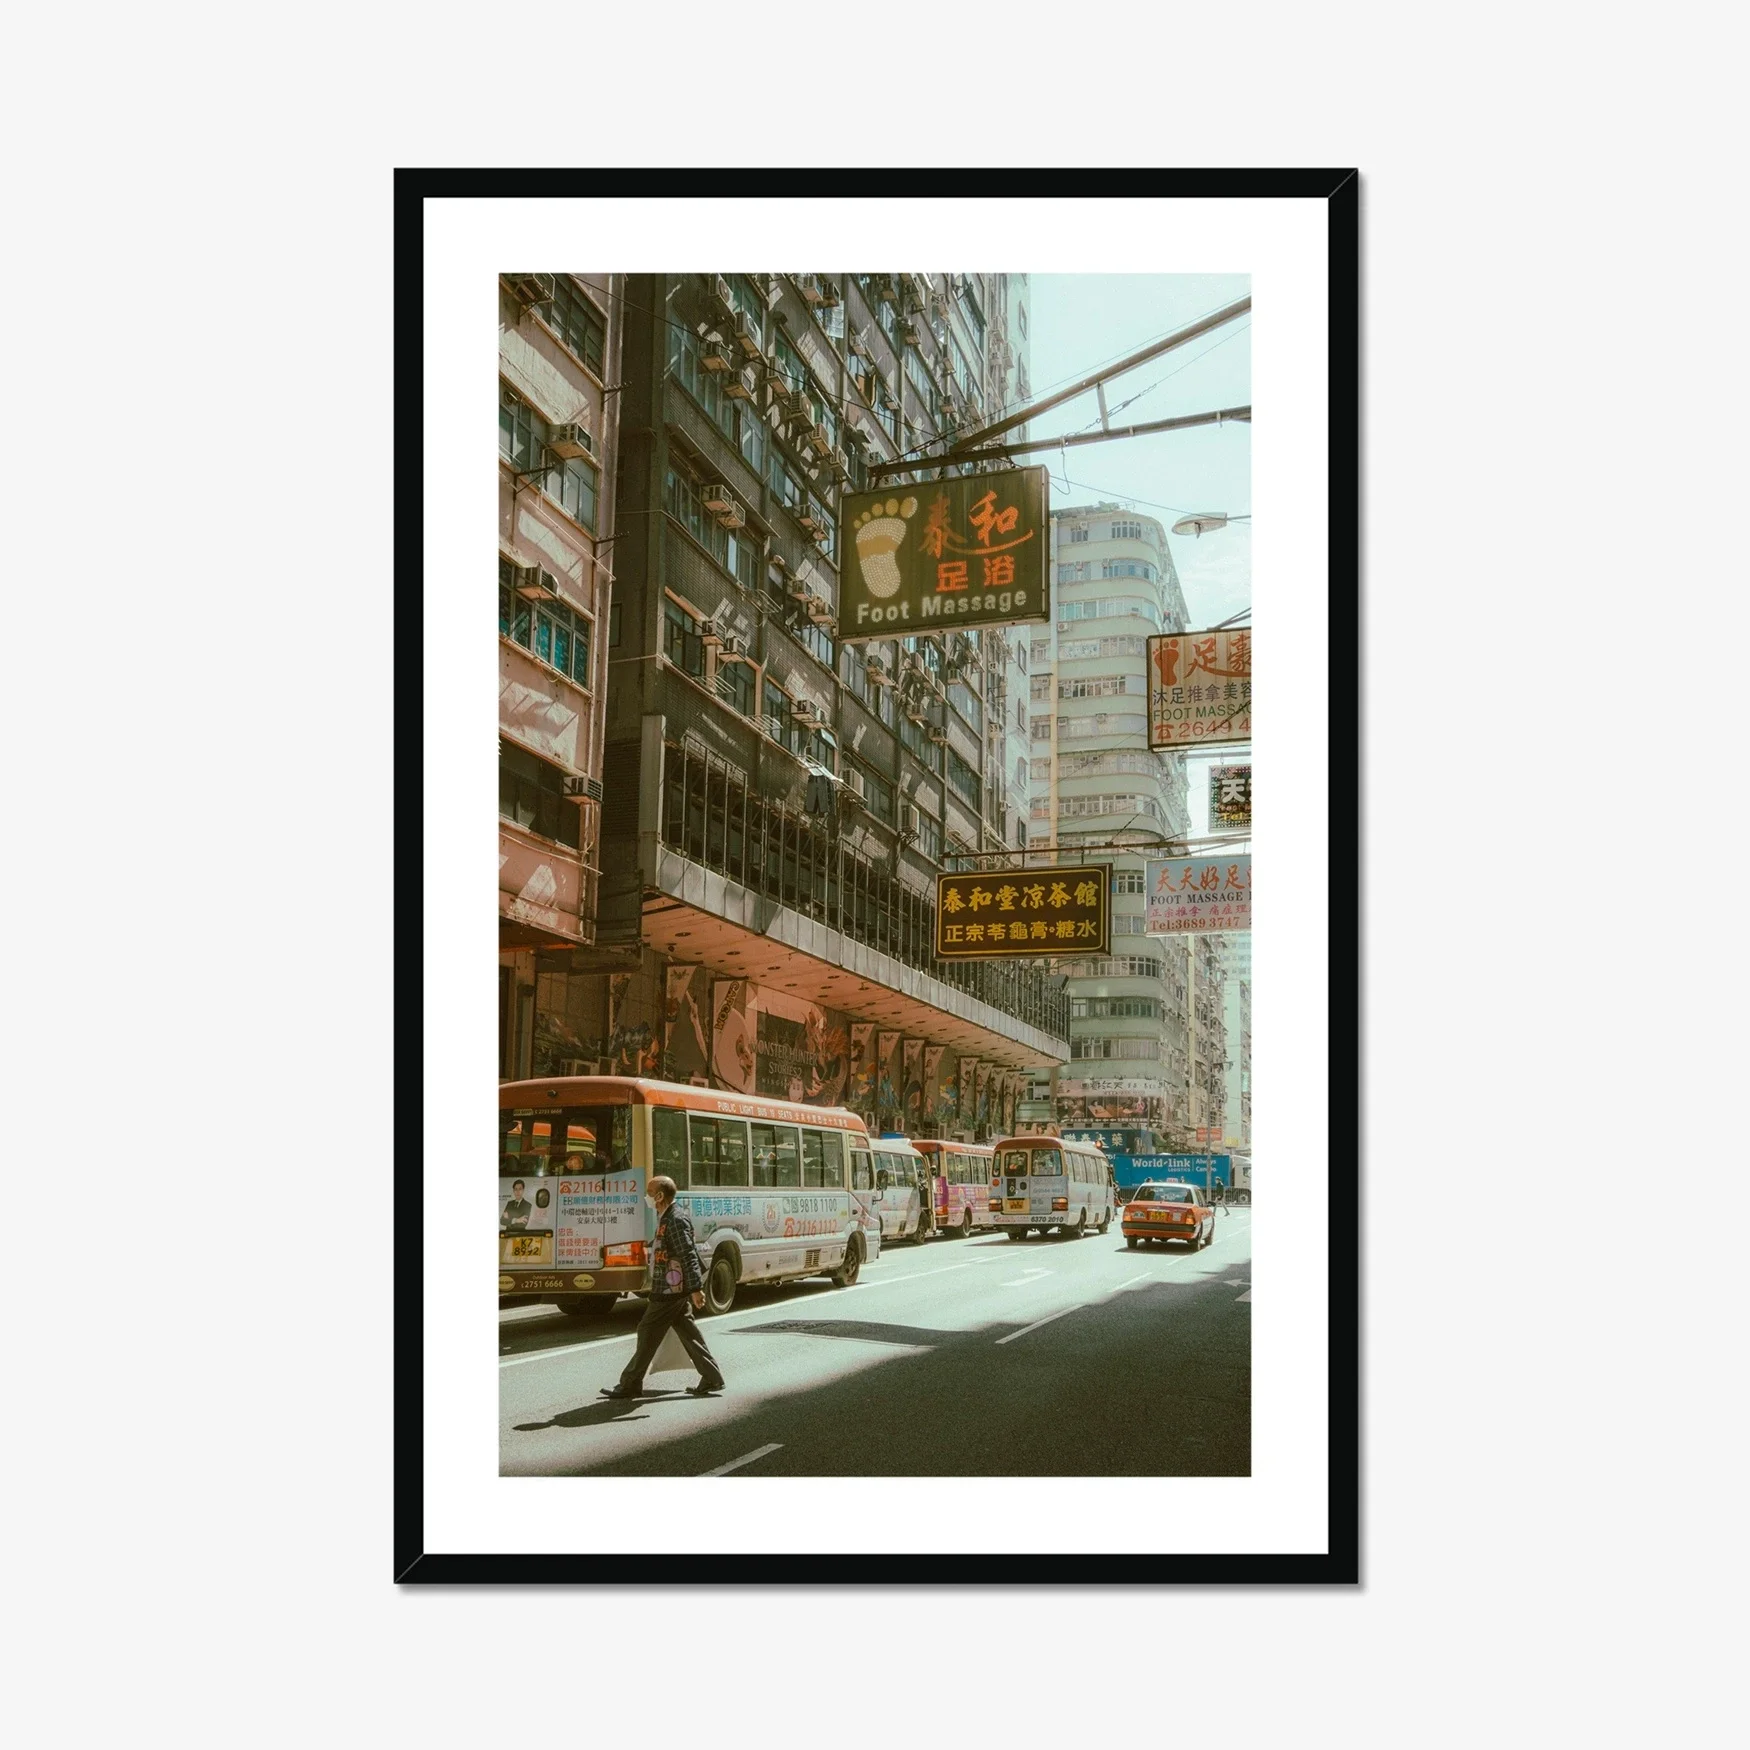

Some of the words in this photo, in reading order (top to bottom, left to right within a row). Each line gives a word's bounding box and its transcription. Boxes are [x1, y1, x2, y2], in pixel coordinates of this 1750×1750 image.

[936, 555, 1015, 593] 足浴
[857, 601, 910, 624] Foot
[921, 590, 1027, 618] Massage
[1153, 707, 1192, 721] FOOT
[1178, 720, 1233, 738] 2649
[1221, 778, 1251, 804] 天
[1157, 864, 1251, 892] 天天好足
[1150, 895, 1181, 905] FOOT
[1187, 891, 1243, 903] MASSAGE
[1209, 903, 1251, 916] 痛症理
[1209, 917, 1240, 928] 3747
[713, 980, 740, 1033] CAPCOM
[750, 1039, 790, 1059] MONSTER
[789, 1047, 819, 1067] HUNTER
[717, 1101, 737, 1113] PUBLIC
[739, 1104, 754, 1115] LIGHT
[757, 1107, 768, 1117] BUS
[777, 1109, 793, 1120] SEATS
[573, 1181, 602, 1194] 2116
[607, 1180, 637, 1193] 1112
[800, 1198, 819, 1213] 9818
[820, 1198, 838, 1213] 1100
[796, 1219, 817, 1238] 2116
[521, 1238, 533, 1248] K7
[525, 1280, 542, 1289] 2751
[545, 1280, 563, 1288] 6666
